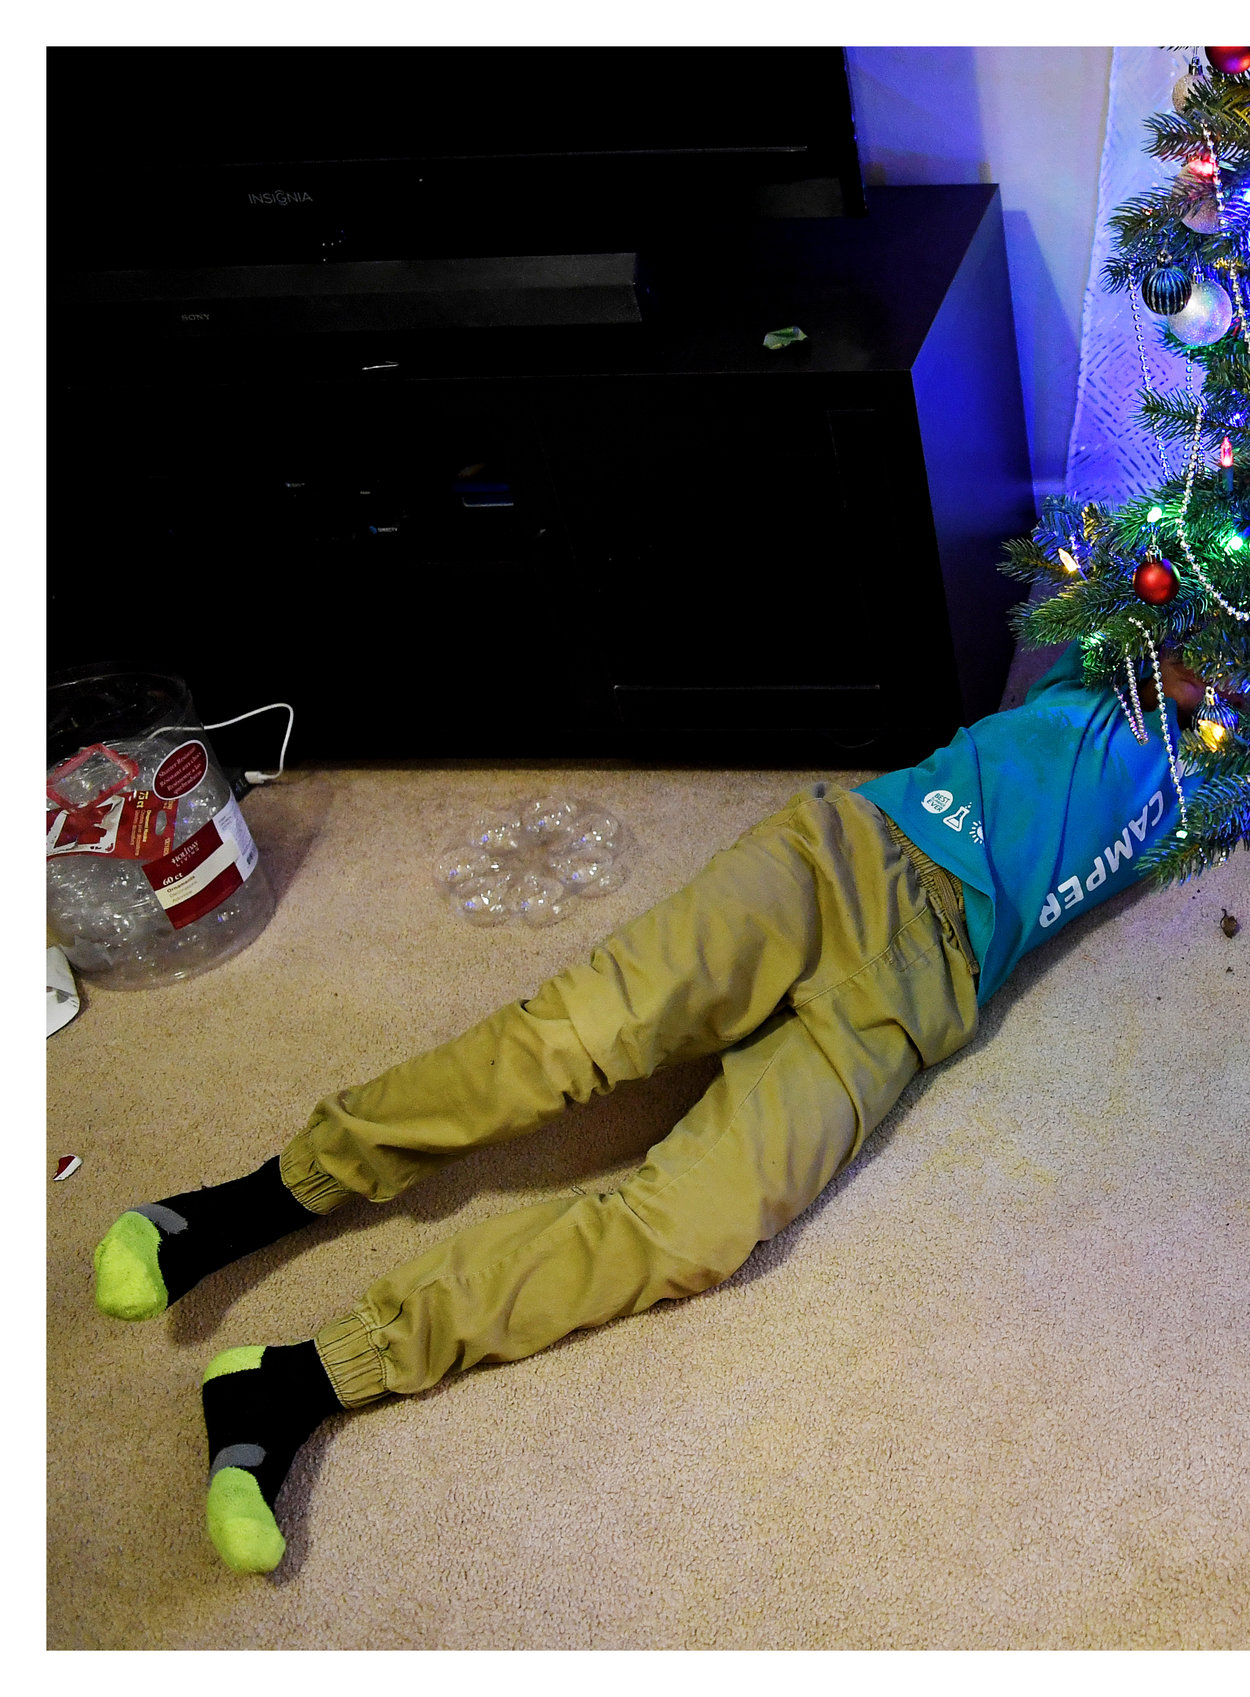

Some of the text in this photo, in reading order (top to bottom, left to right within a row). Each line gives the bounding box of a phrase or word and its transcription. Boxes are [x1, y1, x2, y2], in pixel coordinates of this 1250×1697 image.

[248, 190, 313, 205] INSIGNIA
[927, 799, 943, 812] EVER
[934, 793, 950, 804] BEST
[1039, 790, 1165, 929] CAMPER
[161, 872, 184, 887] 60 ct
